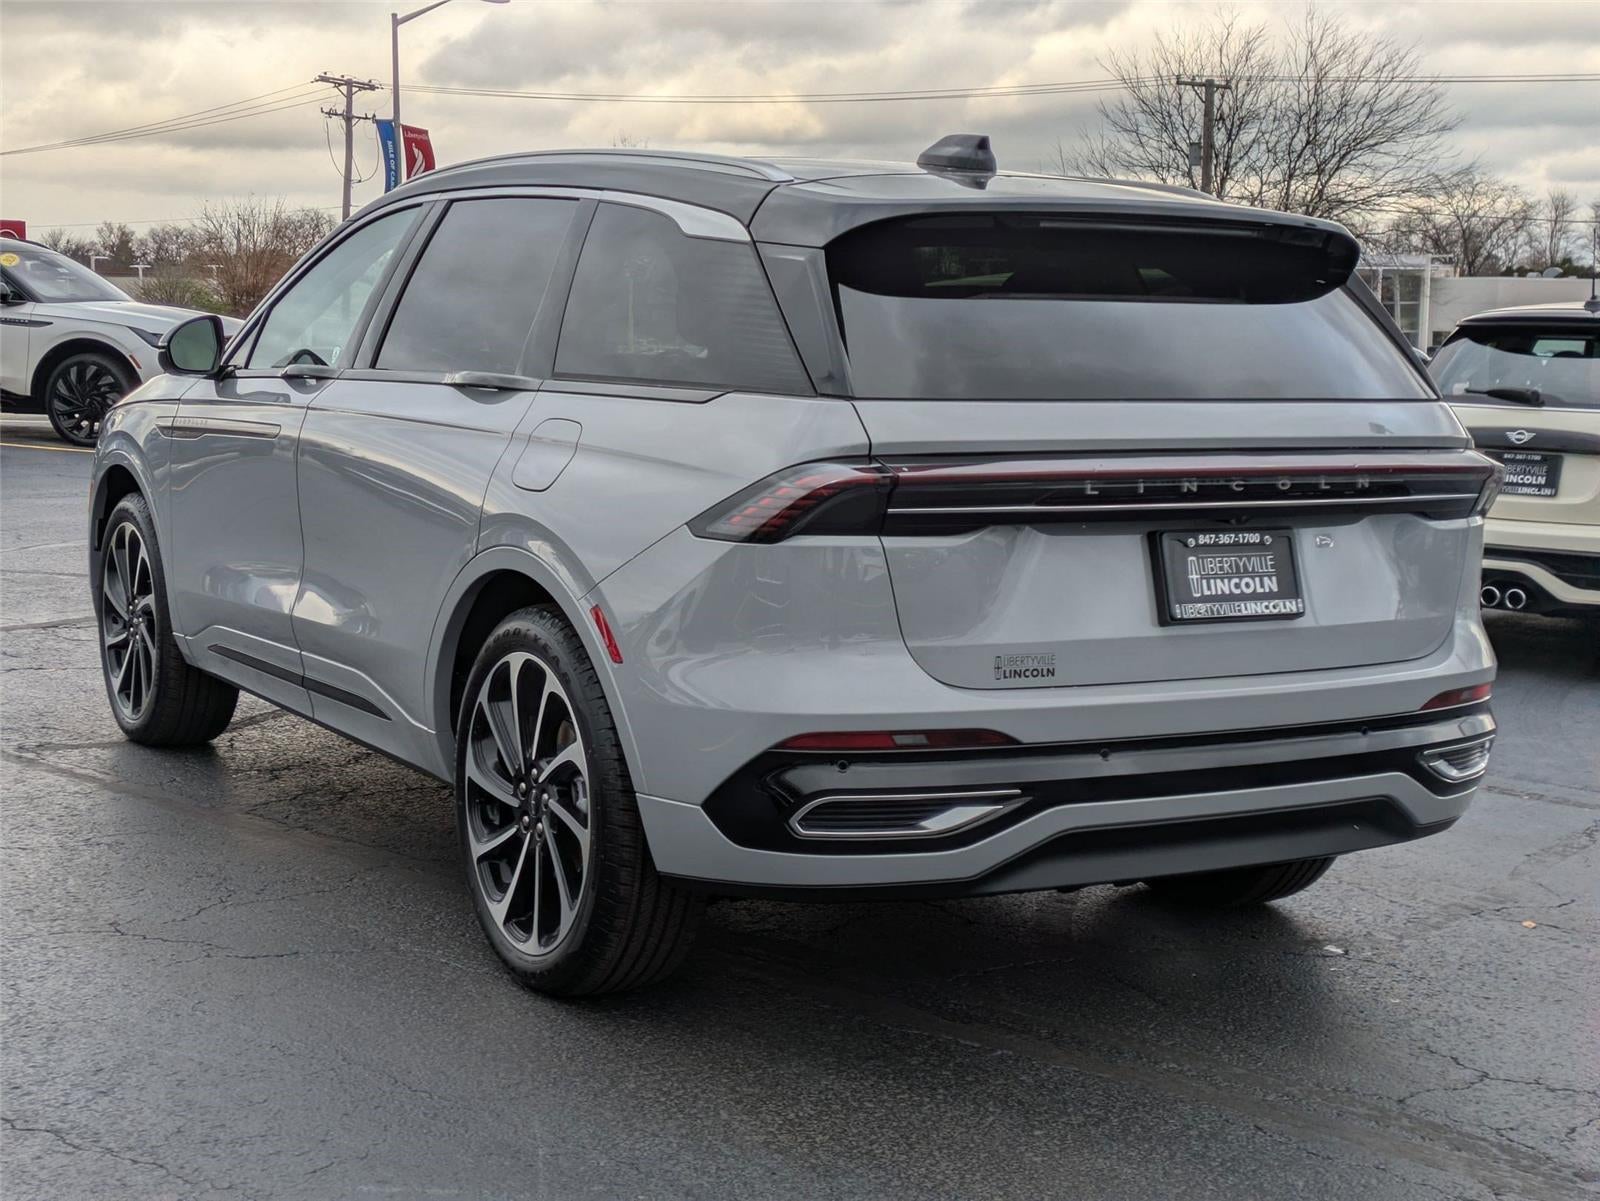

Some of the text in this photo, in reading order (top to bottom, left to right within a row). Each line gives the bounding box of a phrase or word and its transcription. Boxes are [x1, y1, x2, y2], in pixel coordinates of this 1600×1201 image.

[390, 159, 395, 170] OF
[1085, 477, 1369, 495] LINCOLN
[1504, 474, 1546, 485] INCOLN
[1198, 533, 1260, 545] 847-367-1700
[1200, 555, 1276, 574] LIBERTYVILLE
[1202, 576, 1279, 596] LINCOLN
[1002, 667, 1055, 680] LINCOLN
